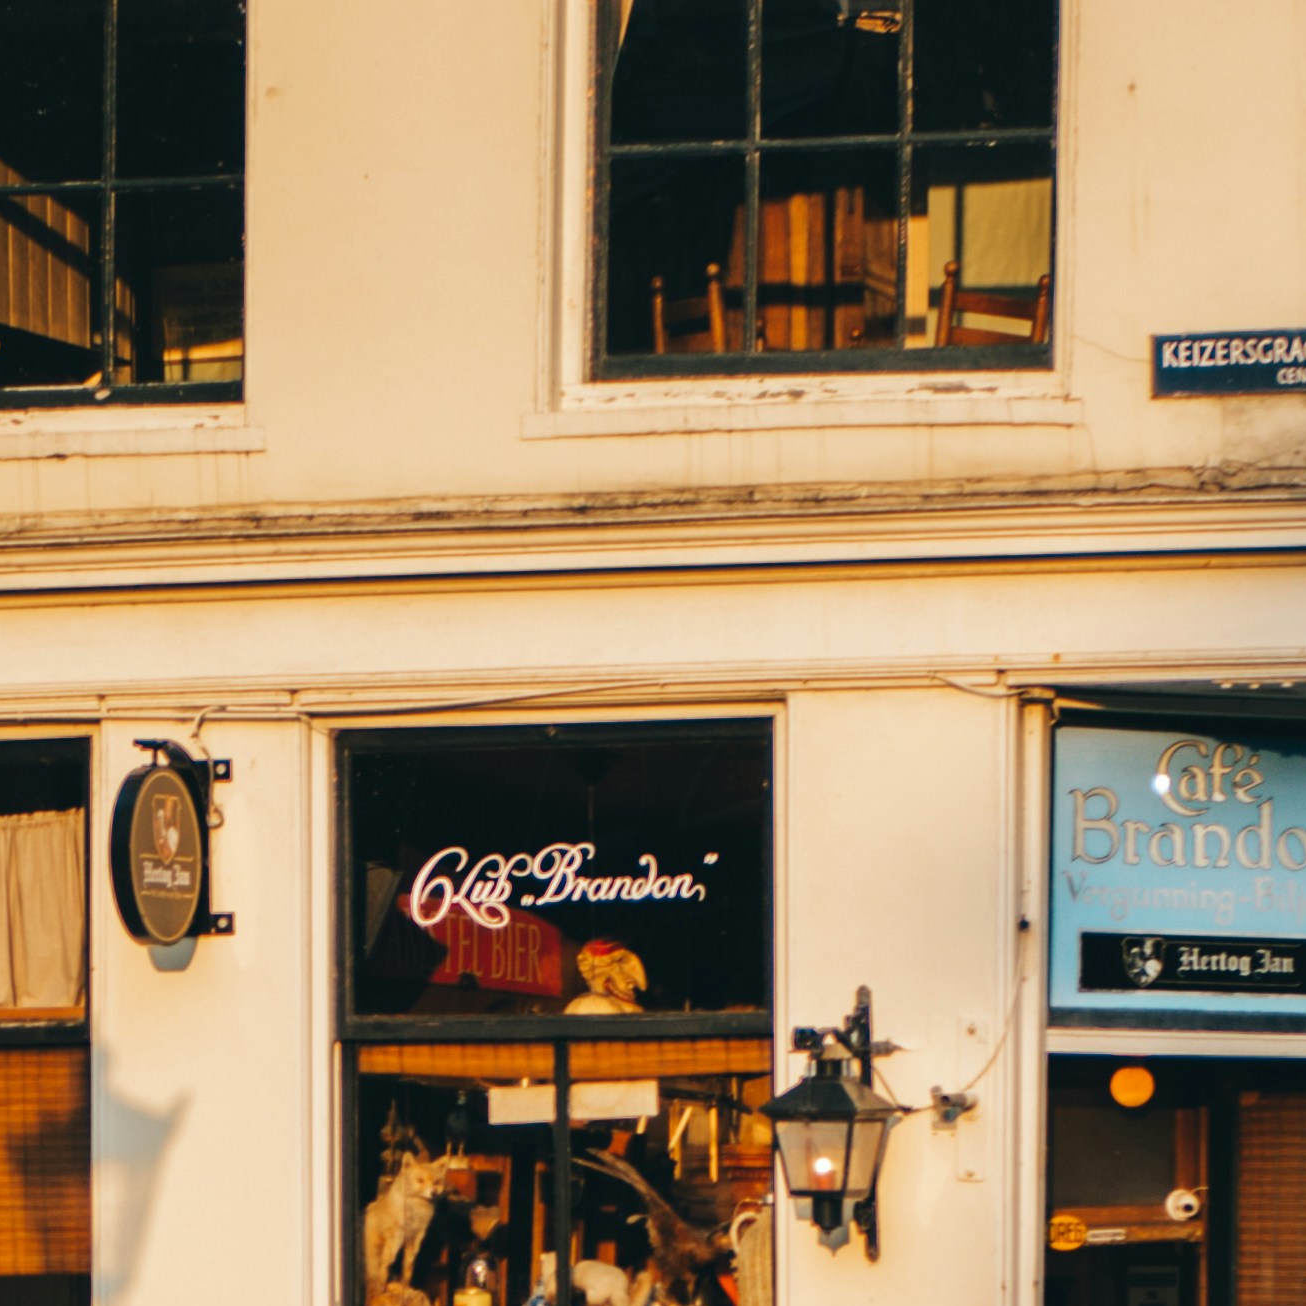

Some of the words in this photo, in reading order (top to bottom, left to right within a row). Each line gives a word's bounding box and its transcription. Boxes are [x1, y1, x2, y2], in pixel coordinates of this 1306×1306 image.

[1153, 738, 1265, 817] Café
[491, 922, 544, 984] BIER
[1178, 947, 1252, 977] Hertog
[1253, 949, 1295, 977] Jan
